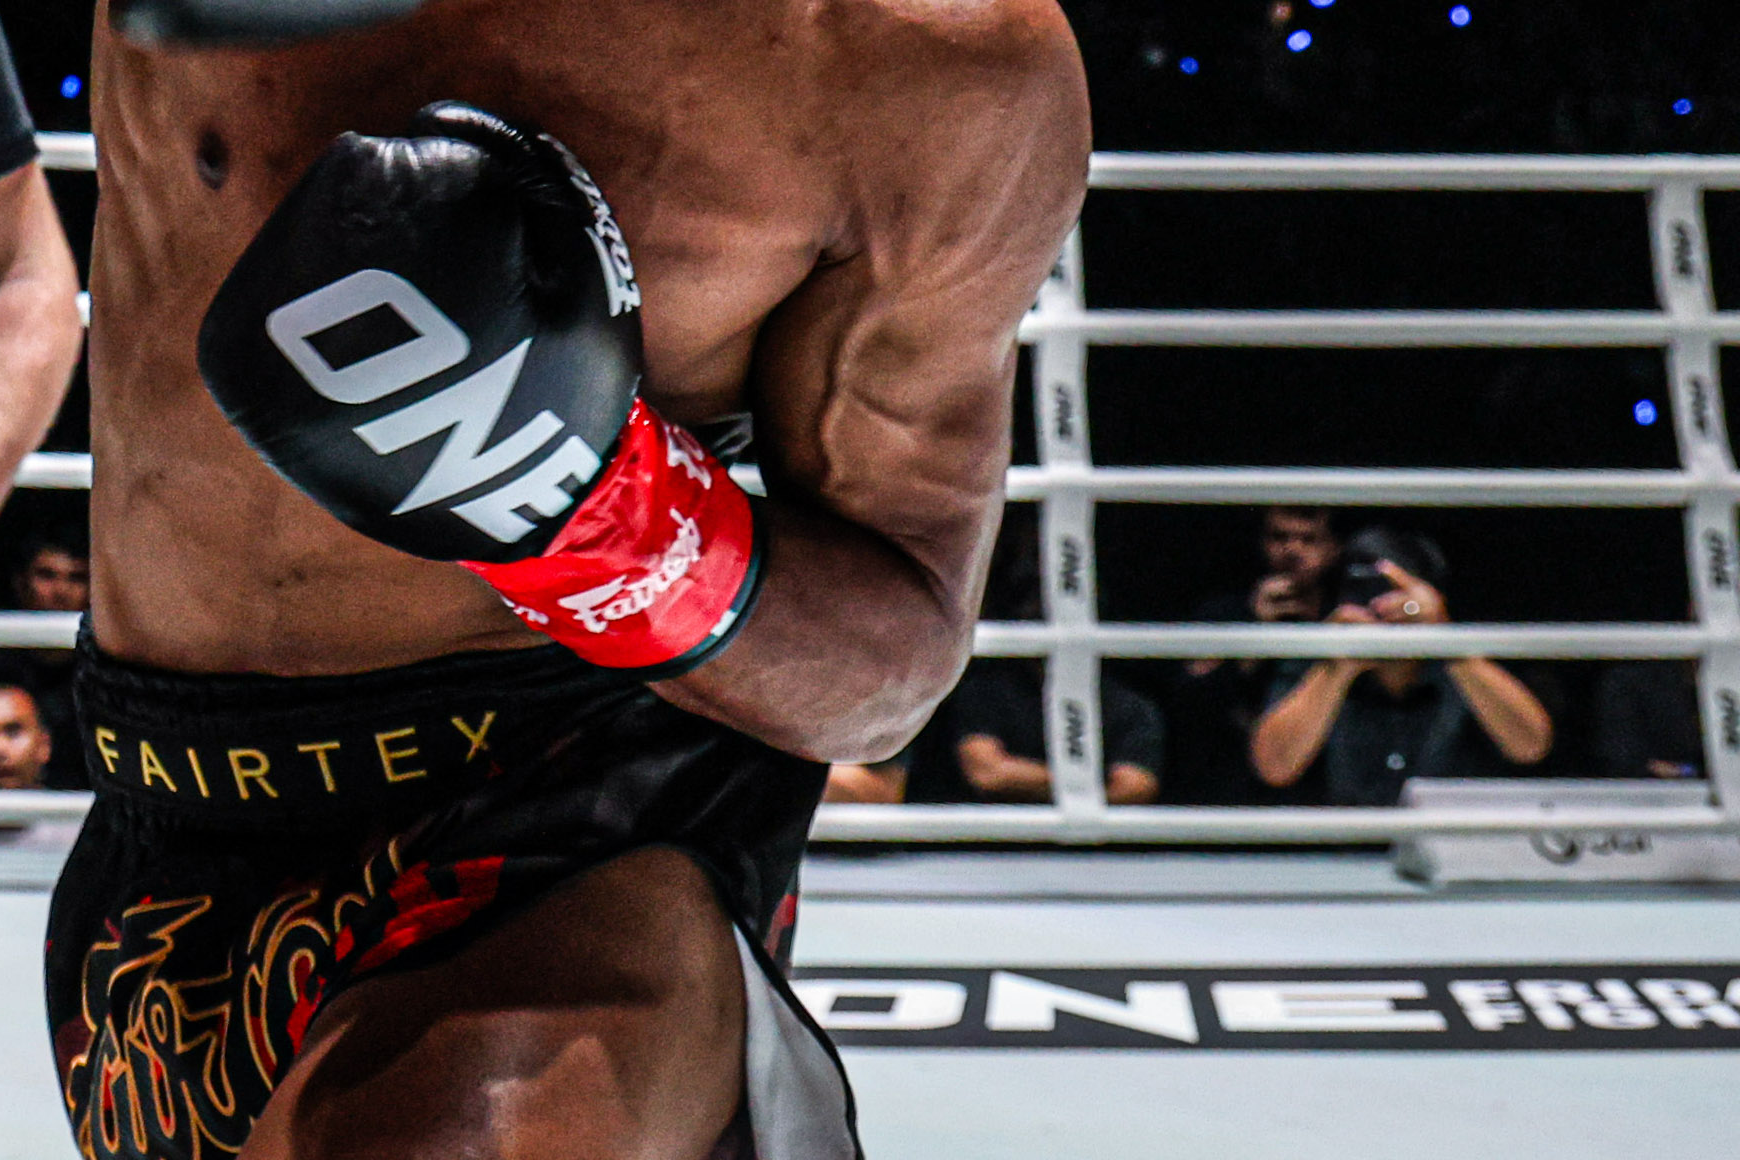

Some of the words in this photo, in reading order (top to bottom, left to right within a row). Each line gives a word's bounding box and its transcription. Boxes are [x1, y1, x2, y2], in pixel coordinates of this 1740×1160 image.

[266, 269, 602, 544] ONE
[94, 711, 498, 801] FAIRTEX
[792, 971, 1448, 1043] ONE
